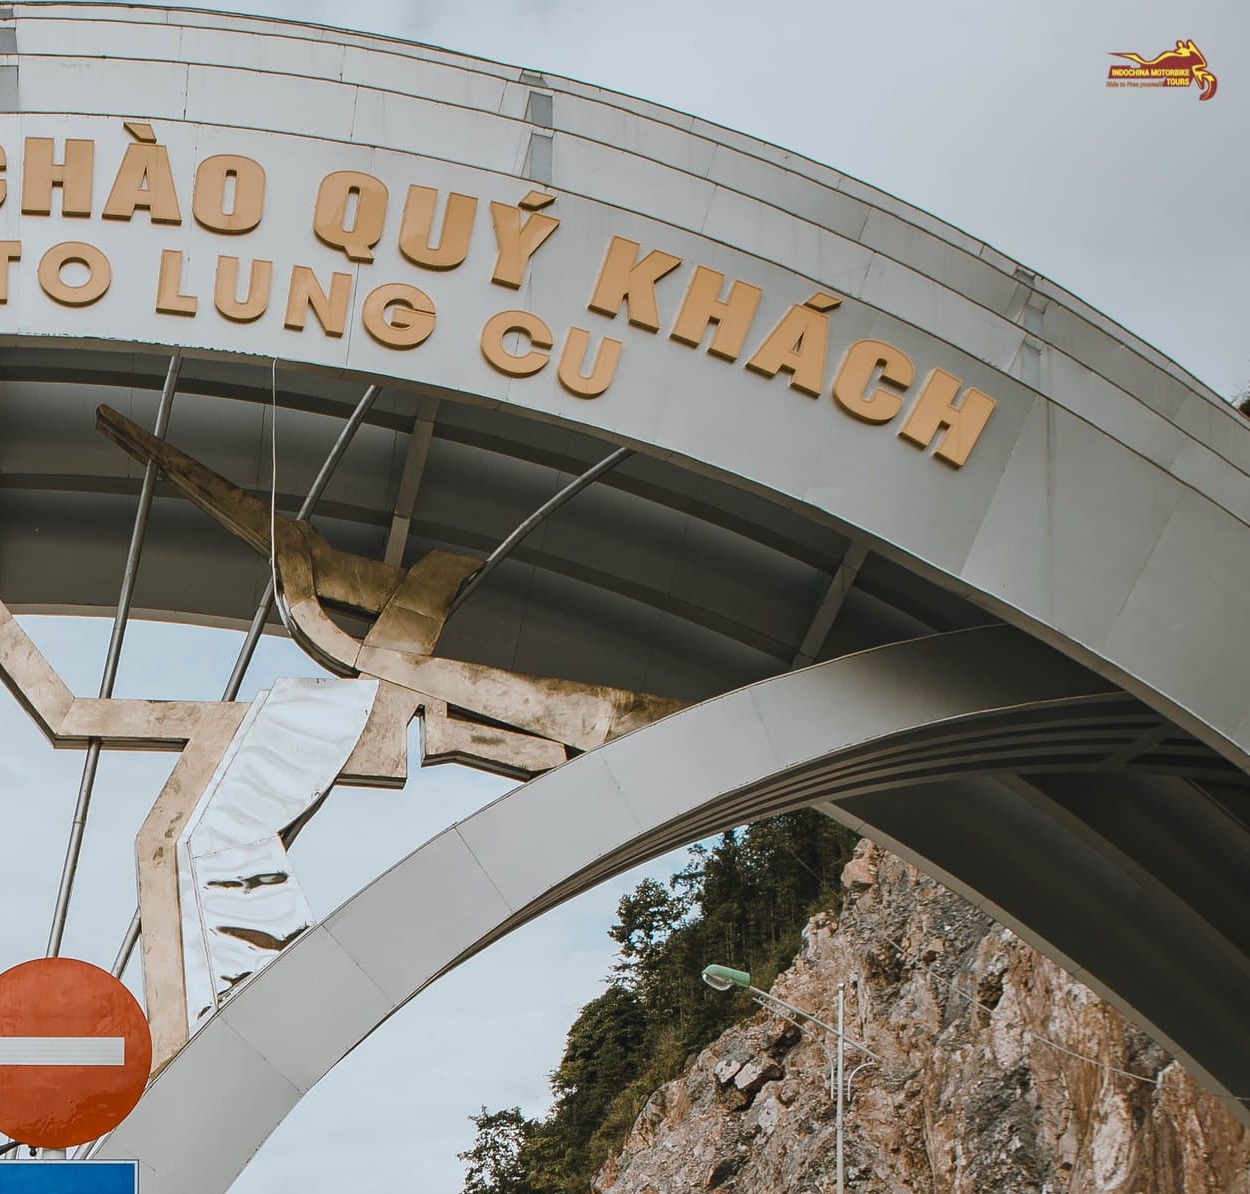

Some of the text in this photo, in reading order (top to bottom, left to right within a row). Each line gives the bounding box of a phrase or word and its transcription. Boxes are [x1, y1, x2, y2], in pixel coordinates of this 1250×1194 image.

[155, 249, 438, 351] LUNG
[479, 309, 623, 401] CU
[312, 169, 561, 291] QUÝ
[587, 234, 998, 471] KHÁCH
